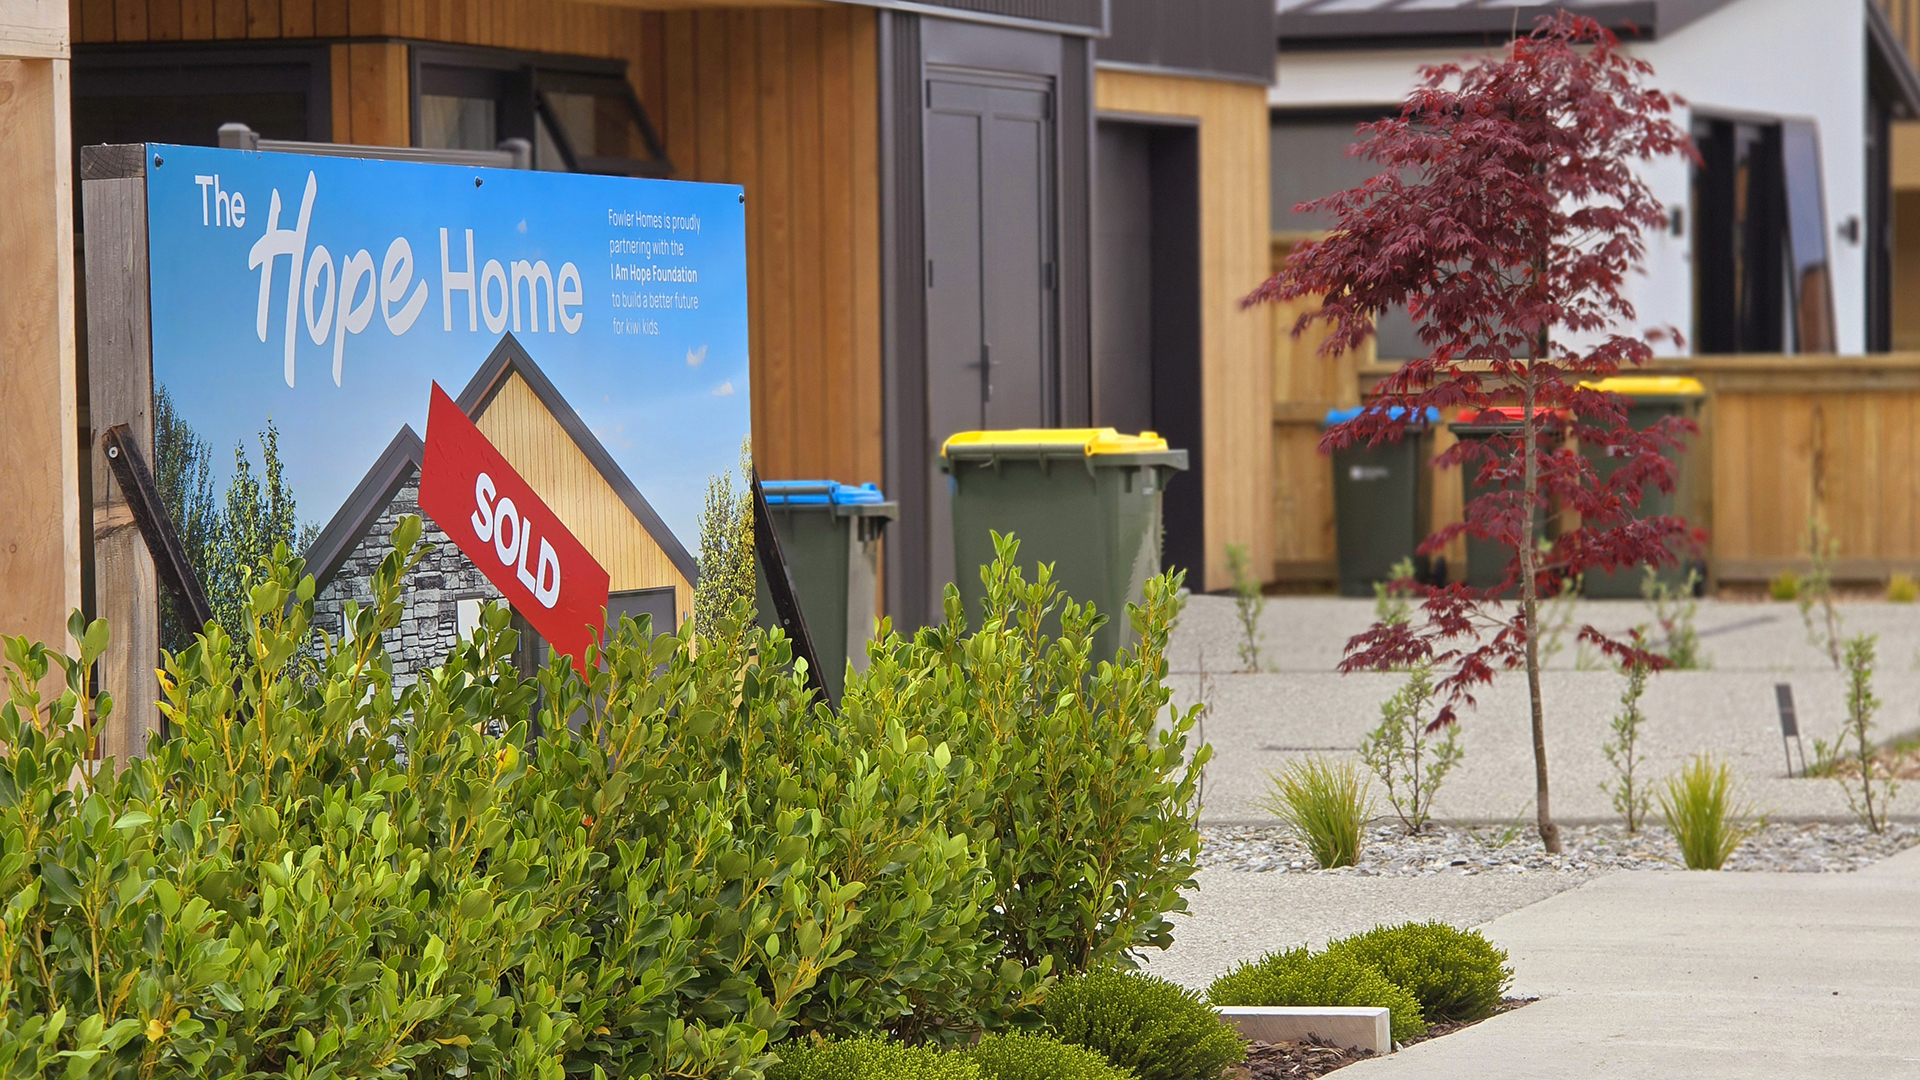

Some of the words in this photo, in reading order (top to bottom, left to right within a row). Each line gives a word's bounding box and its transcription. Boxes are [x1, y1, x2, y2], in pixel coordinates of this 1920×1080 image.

[608, 208, 635, 227] Fowler
[635, 210, 663, 229] Homes
[663, 212, 671, 229] is
[672, 213, 701, 235] proudly
[609, 237, 651, 260] partnering
[652, 238, 670, 256] with
[670, 239, 685, 257] the
[195, 174, 246, 228] The
[248, 170, 429, 389] Hope
[439, 227, 584, 334] Home
[610, 263, 614, 280] I
[615, 263, 629, 281] Am
[630, 264, 651, 286] Hope
[652, 264, 698, 283] Foundation
[611, 292, 621, 308] to
[622, 290, 642, 308] build
[643, 295, 648, 309] a
[649, 291, 673, 309] better
[674, 291, 699, 310] future
[612, 317, 625, 335] for
[625, 317, 642, 335] kiwi
[470, 472, 561, 609] SOLD
